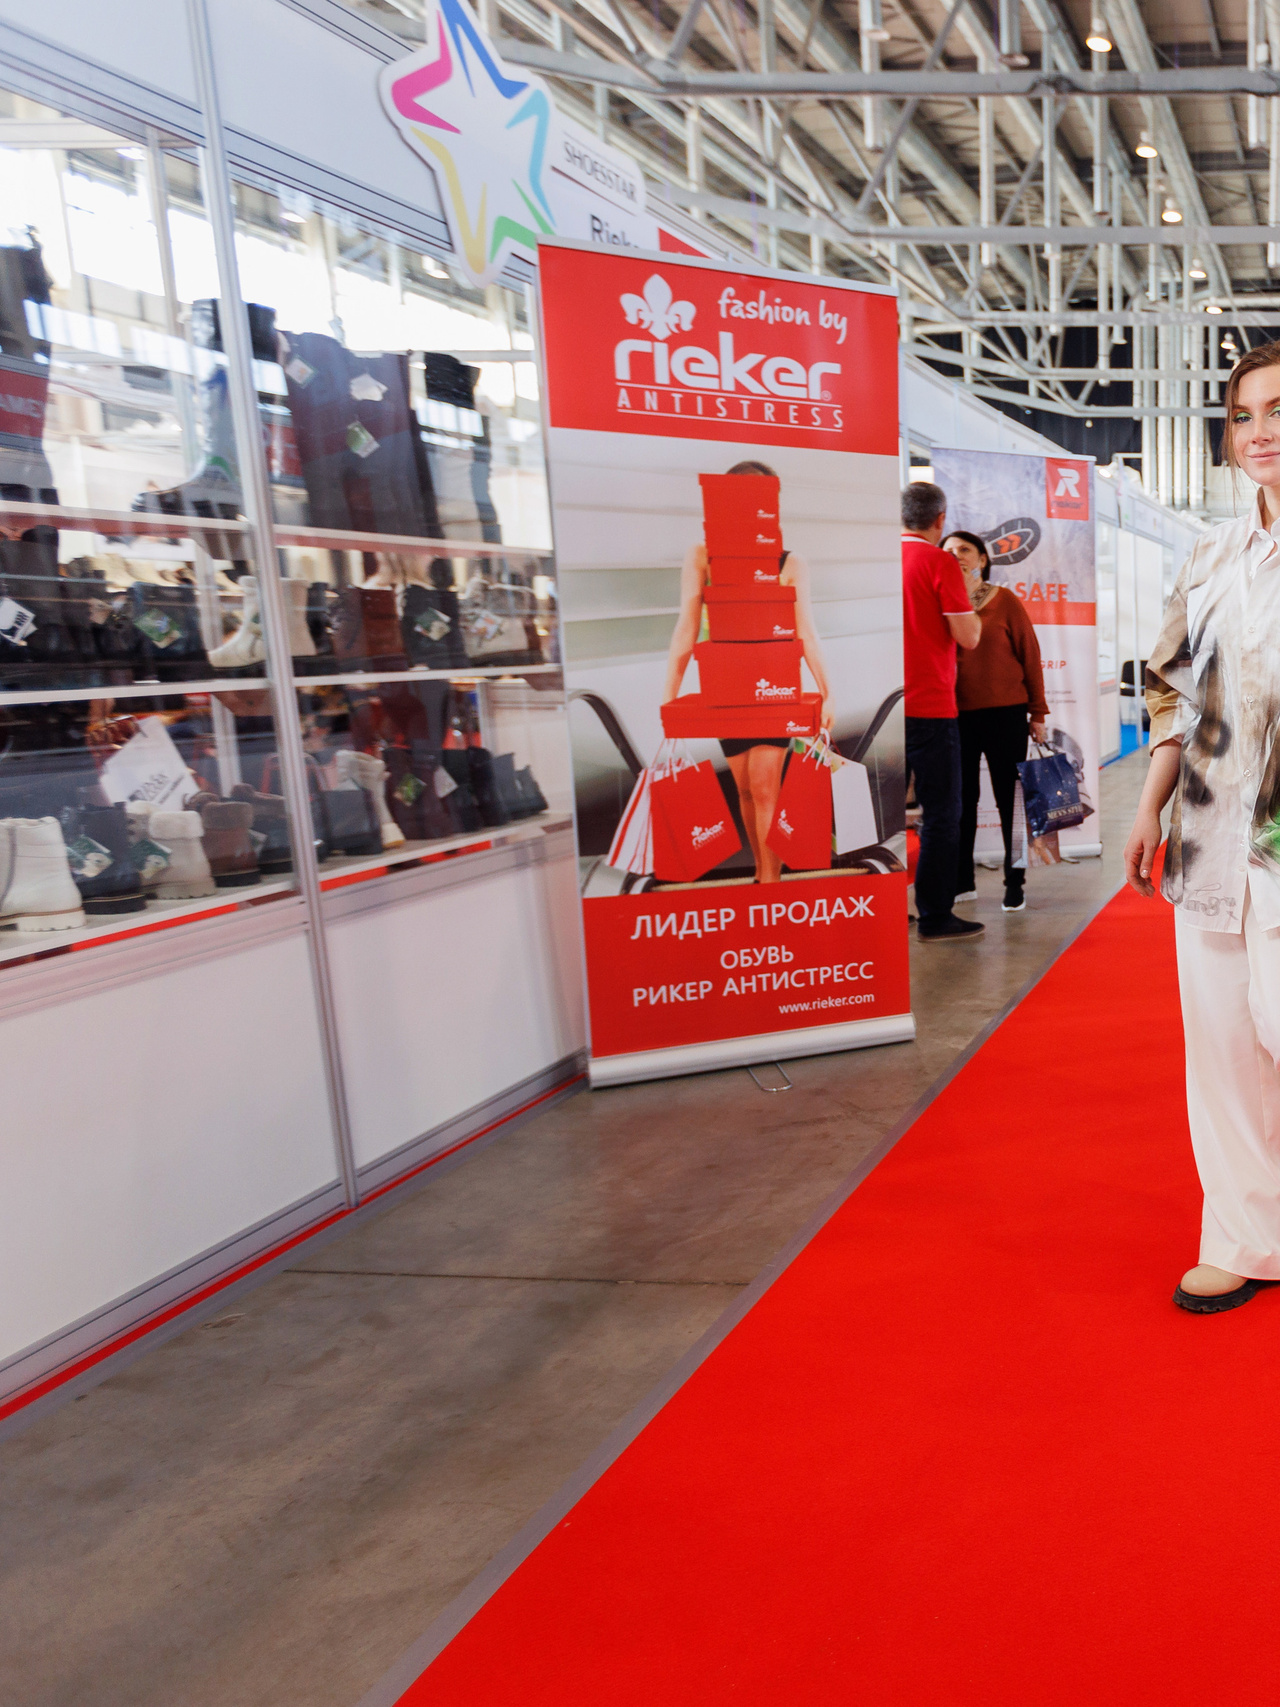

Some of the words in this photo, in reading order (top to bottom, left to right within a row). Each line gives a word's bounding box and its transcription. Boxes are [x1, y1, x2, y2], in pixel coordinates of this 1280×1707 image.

[717, 286, 811, 325] fashion
[818, 299, 848, 345] by
[617, 387, 844, 428] ANTISTRESS
[1014, 582, 1068, 602] SAFE
[630, 907, 736, 940] ЛИДЕР
[748, 895, 876, 928] ПРОДАЖ
[720, 945, 794, 970] ОБУВЬ
[632, 980, 713, 1008] РИКЕР
[722, 961, 875, 997] АНТИСТРЕСС
[778, 993, 876, 1014] www.rieker.com
